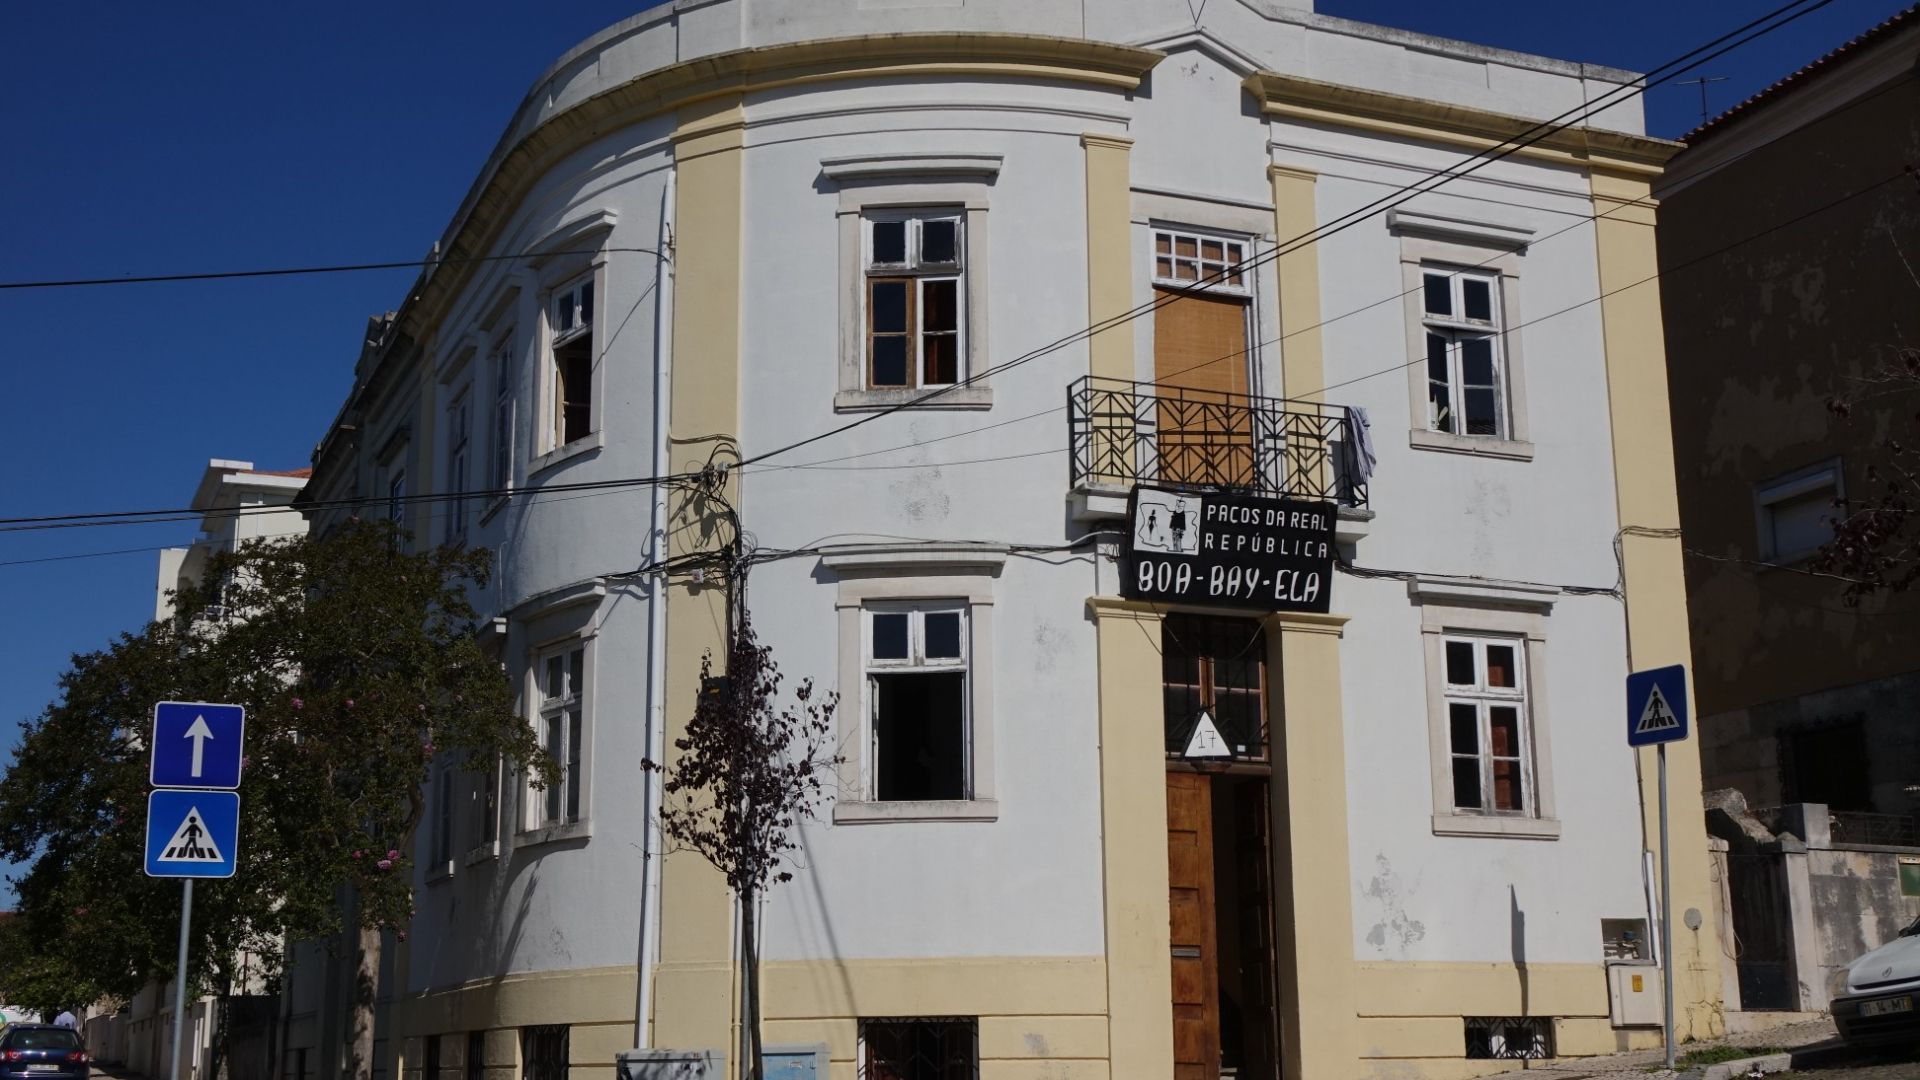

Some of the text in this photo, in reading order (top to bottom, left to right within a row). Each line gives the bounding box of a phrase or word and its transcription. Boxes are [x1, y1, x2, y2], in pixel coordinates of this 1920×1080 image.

[1265, 509, 1285, 527] DA
[1290, 511, 1328, 531] REAL
[1204, 532, 1327, 558] REPÚBLICA
[1195, 730, 1217, 749] 17
